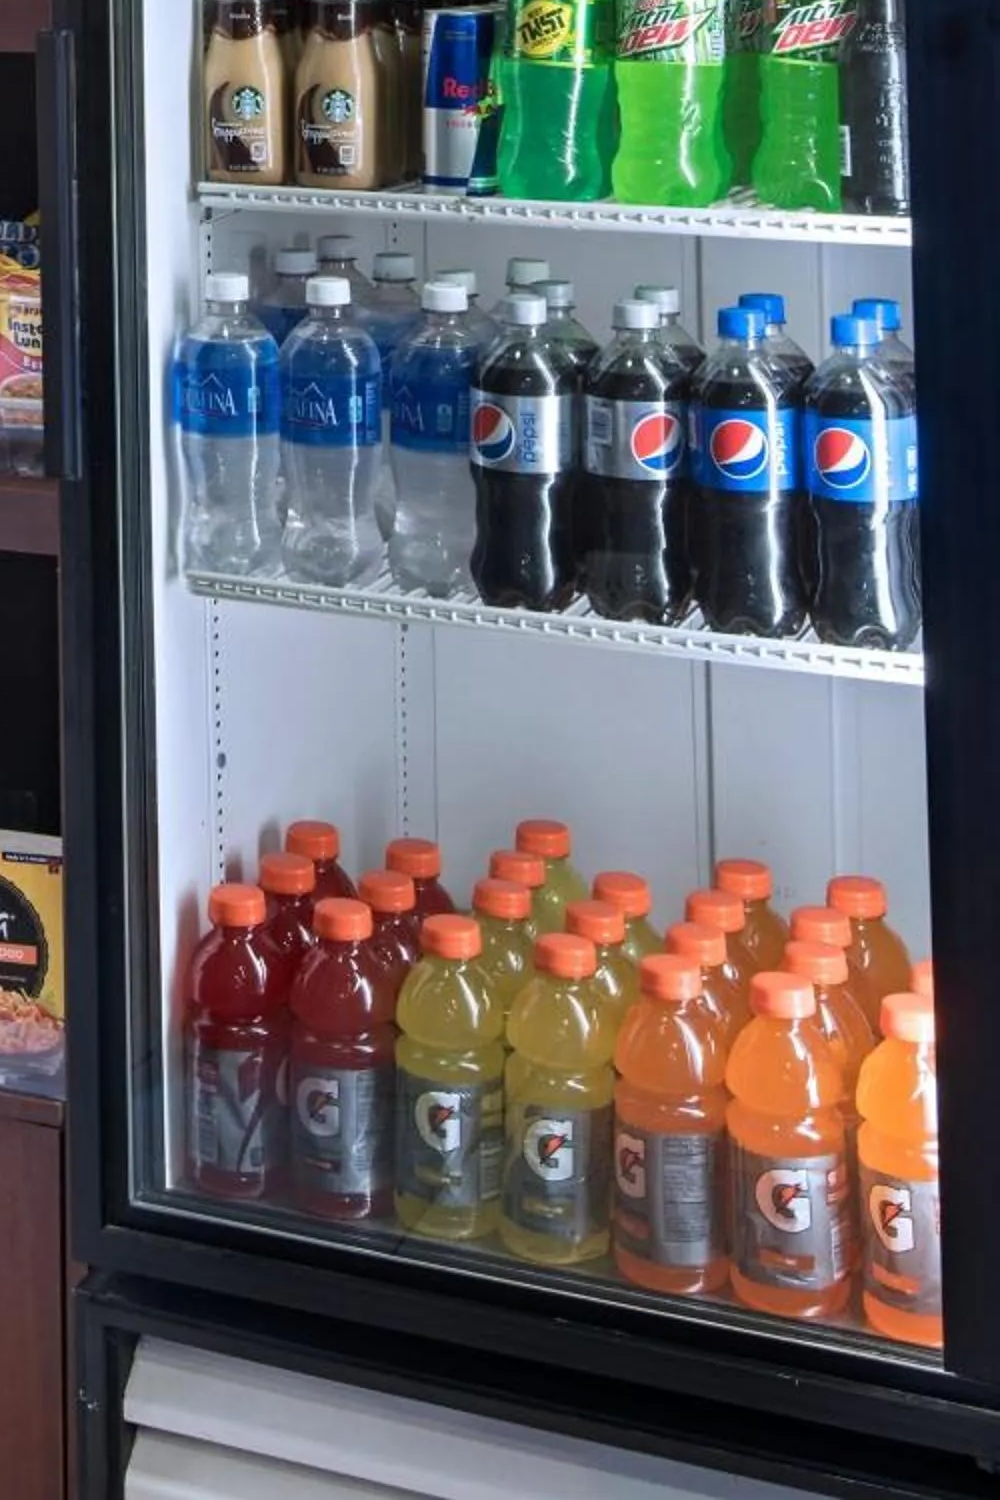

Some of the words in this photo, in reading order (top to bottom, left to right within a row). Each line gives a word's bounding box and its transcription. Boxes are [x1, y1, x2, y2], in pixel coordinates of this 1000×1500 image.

[15, 331, 41, 347] Lun
[519, 412, 539, 463] pepsi
[415, 1091, 462, 1153] G
[523, 1118, 574, 1182] G
[756, 1169, 812, 1234] G
[869, 1185, 916, 1253] G
